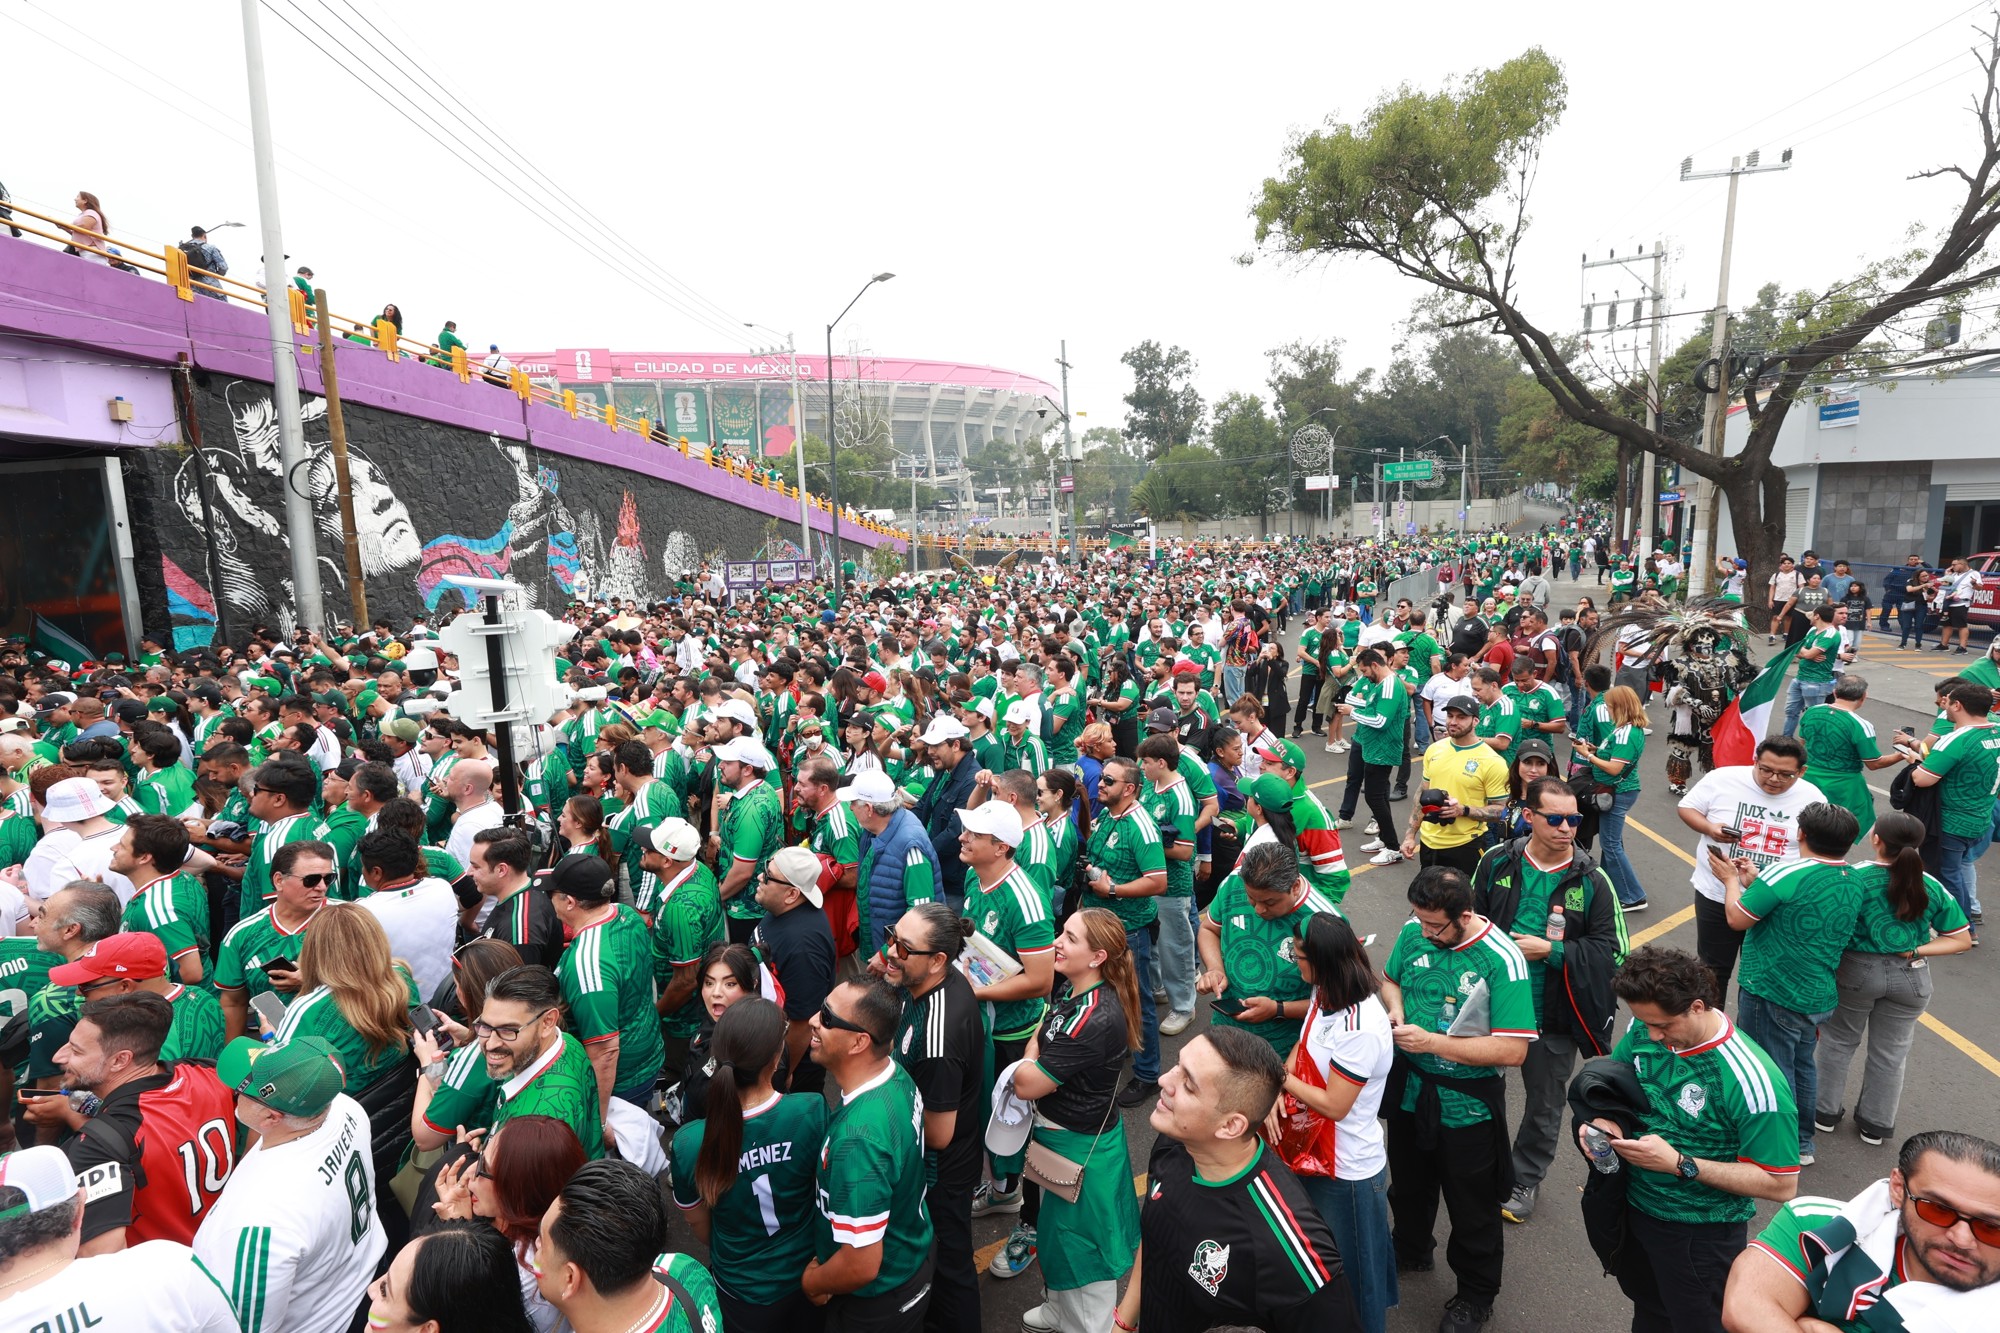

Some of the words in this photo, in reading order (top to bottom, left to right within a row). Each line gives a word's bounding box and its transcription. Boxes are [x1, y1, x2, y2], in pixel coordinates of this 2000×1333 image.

[634, 362, 704, 374] CIUDAD
[712, 363, 737, 373] DE
[1742, 802, 1768, 820] MX
[1738, 820, 1789, 856] 26
[178, 1117, 234, 1216] 10
[318, 1122, 355, 1186] JAVIER
[751, 1173, 781, 1237] 1
